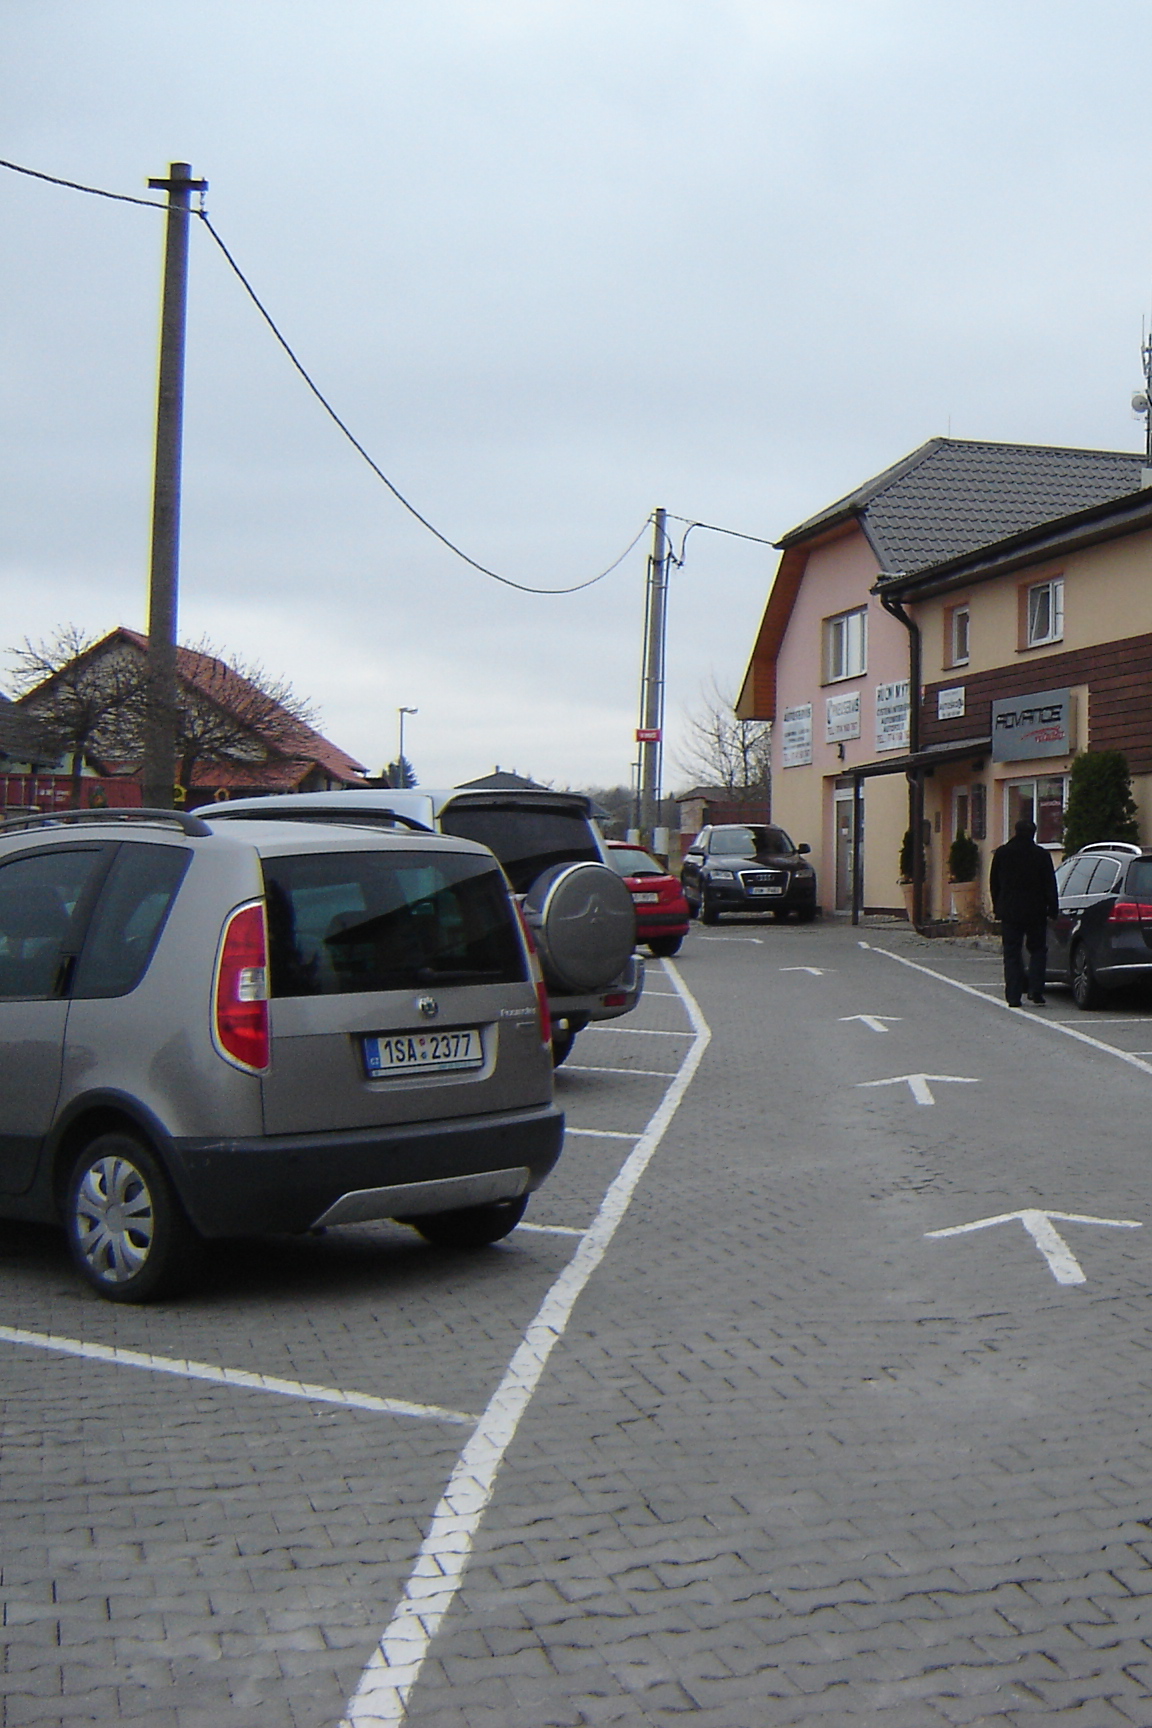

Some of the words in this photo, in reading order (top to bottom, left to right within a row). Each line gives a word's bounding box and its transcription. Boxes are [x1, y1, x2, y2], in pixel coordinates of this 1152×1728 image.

[995, 704, 1063, 730] ADVANCE
[384, 1038, 417, 1064] 1SA
[430, 1034, 471, 1059] 2377
